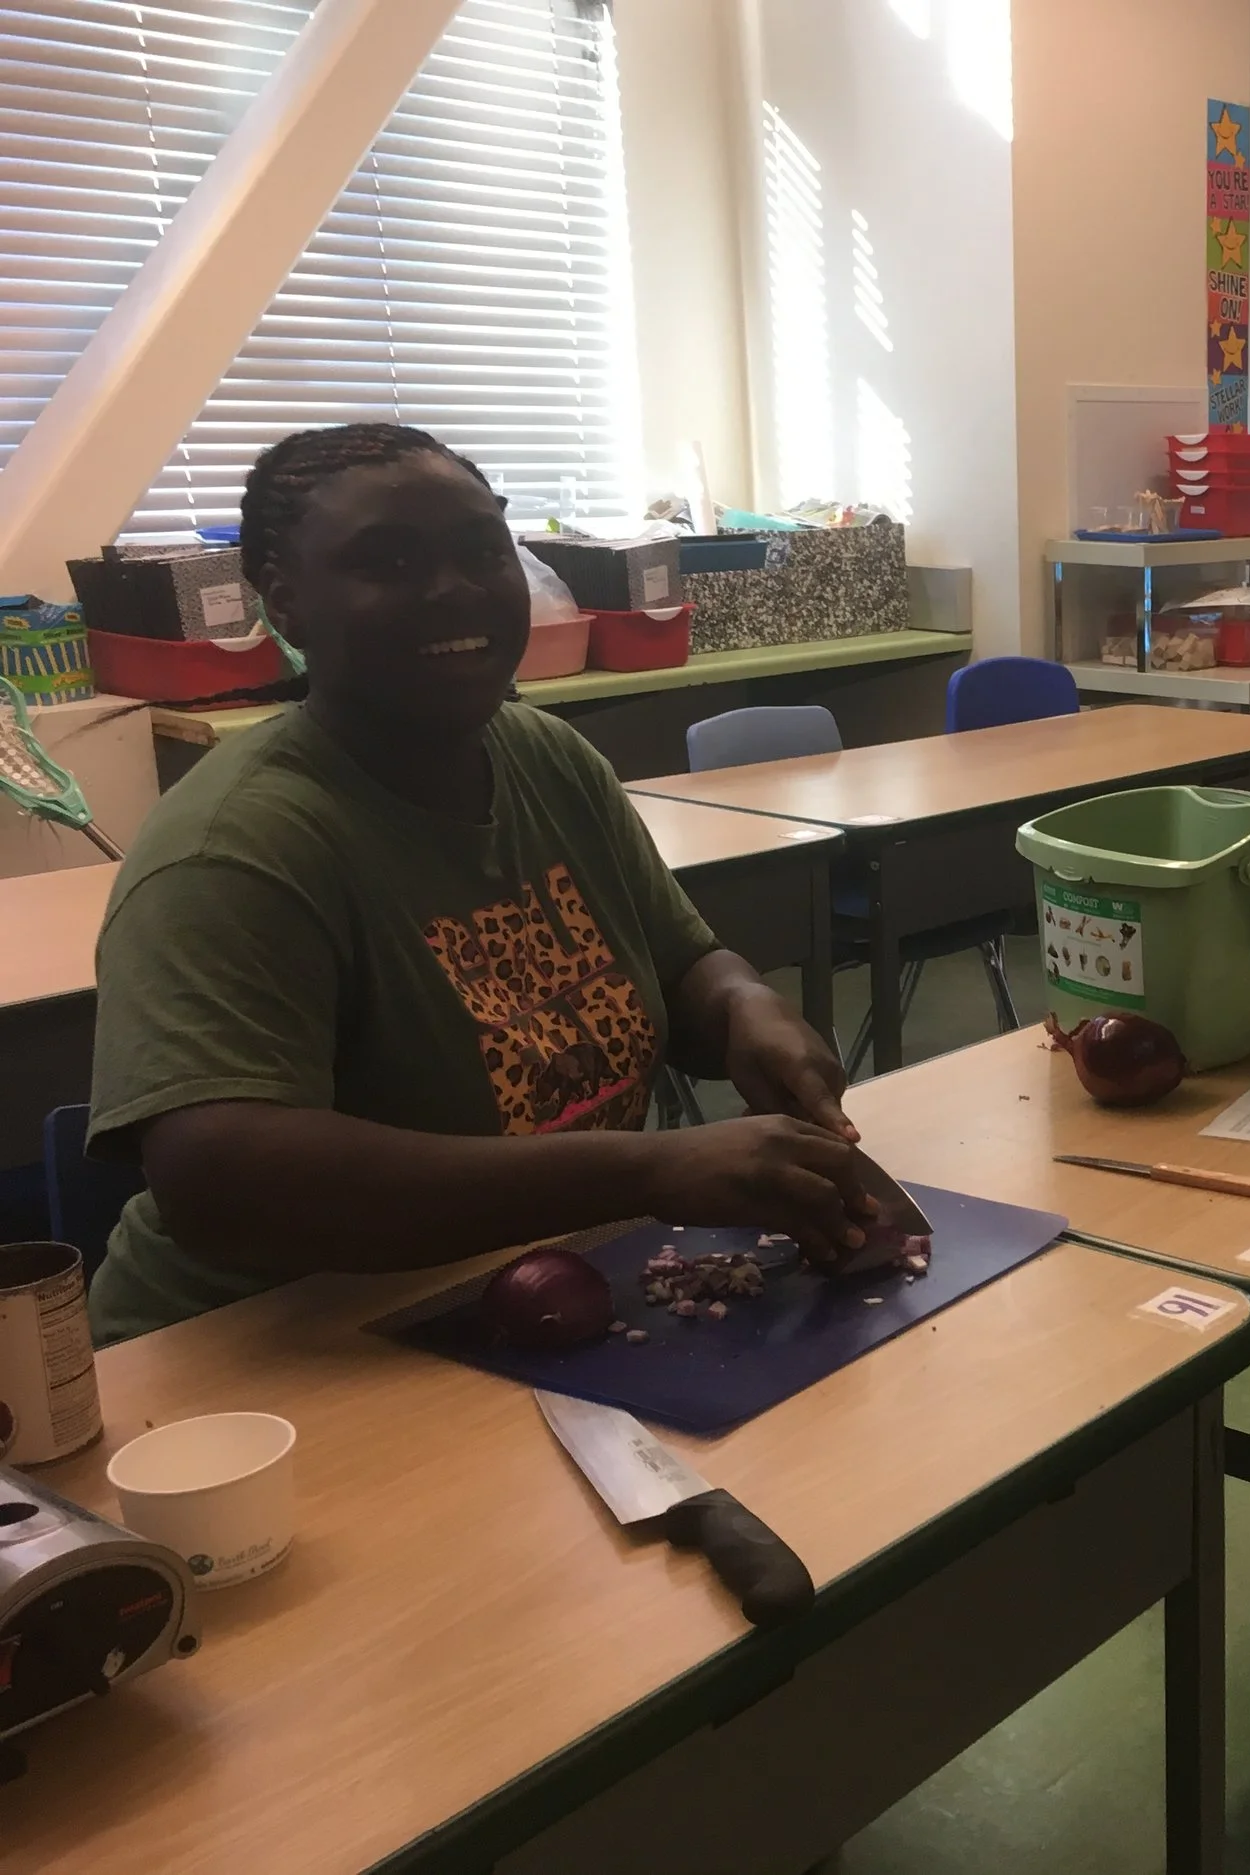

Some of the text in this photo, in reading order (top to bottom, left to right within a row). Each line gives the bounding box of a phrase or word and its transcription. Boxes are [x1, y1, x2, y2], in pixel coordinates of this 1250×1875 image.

[1208, 170, 1248, 191] YOURE
[1210, 193, 1217, 209] A
[1210, 270, 1247, 298] SHINE
[1221, 298, 1242, 321] ON!
[1210, 379, 1247, 410] STELLAR
[1062, 891, 1101, 909] COMPOST
[1157, 1294, 1221, 1318] 16
